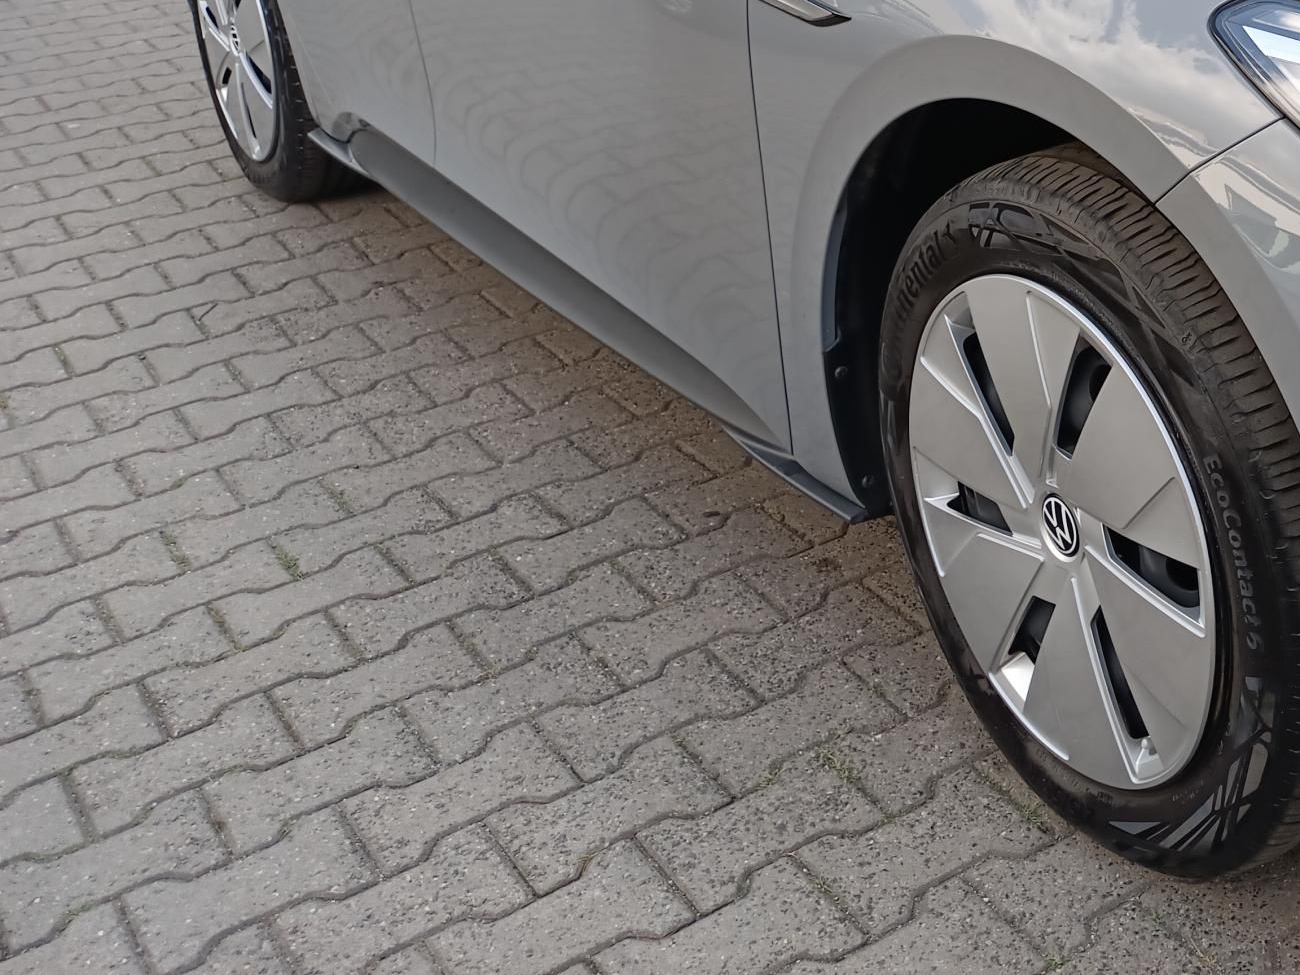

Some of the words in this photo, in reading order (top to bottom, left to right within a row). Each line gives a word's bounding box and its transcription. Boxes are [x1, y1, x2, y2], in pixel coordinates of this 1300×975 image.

[1042, 495, 1078, 554] VW
[1203, 454, 1262, 626] EcoContact
[1246, 630, 1263, 651] 6
